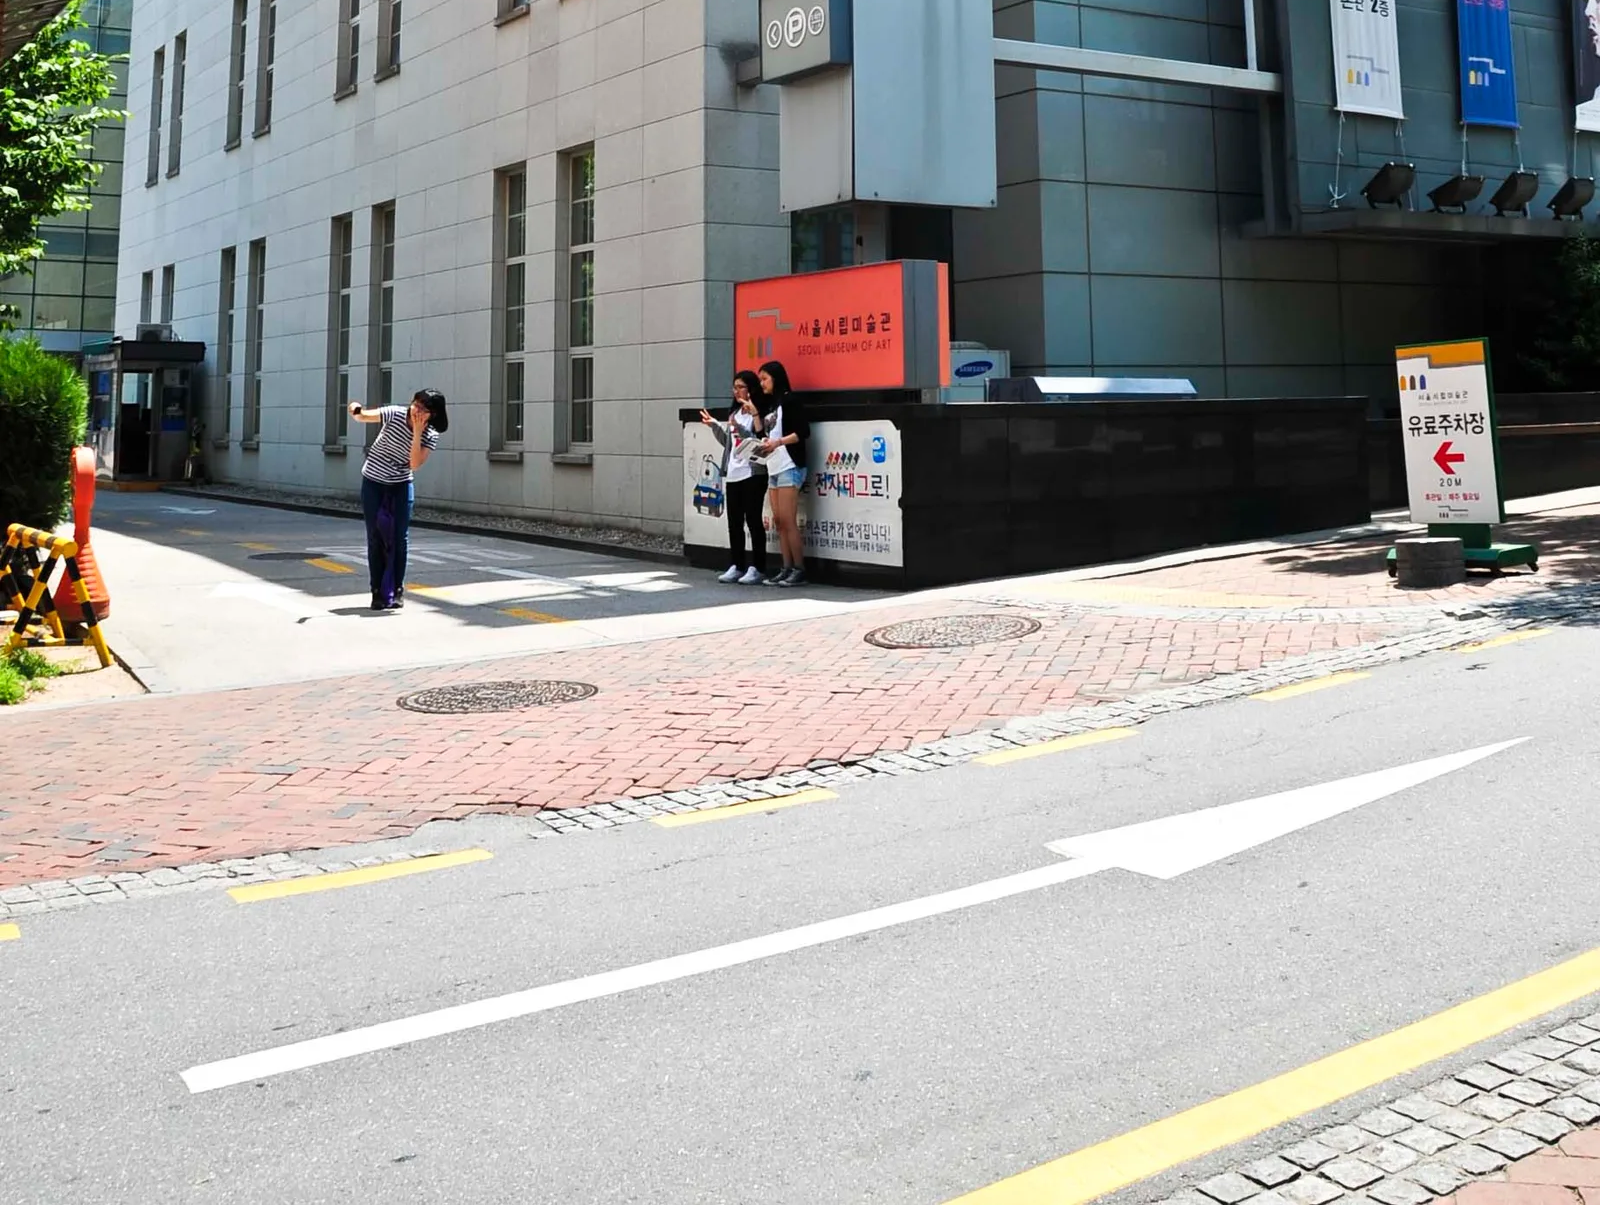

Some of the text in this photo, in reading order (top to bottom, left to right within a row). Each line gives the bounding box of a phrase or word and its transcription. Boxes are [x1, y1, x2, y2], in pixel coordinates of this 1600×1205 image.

[798, 312, 891, 338] 서울시립미술관
[797, 338, 891, 356] SEOUL MUSEUM OF ART
[1408, 412, 1485, 437] 유료주차장
[815, 472, 890, 499] 전자태그로!
[846, 522, 891, 542] 없어집니다!
